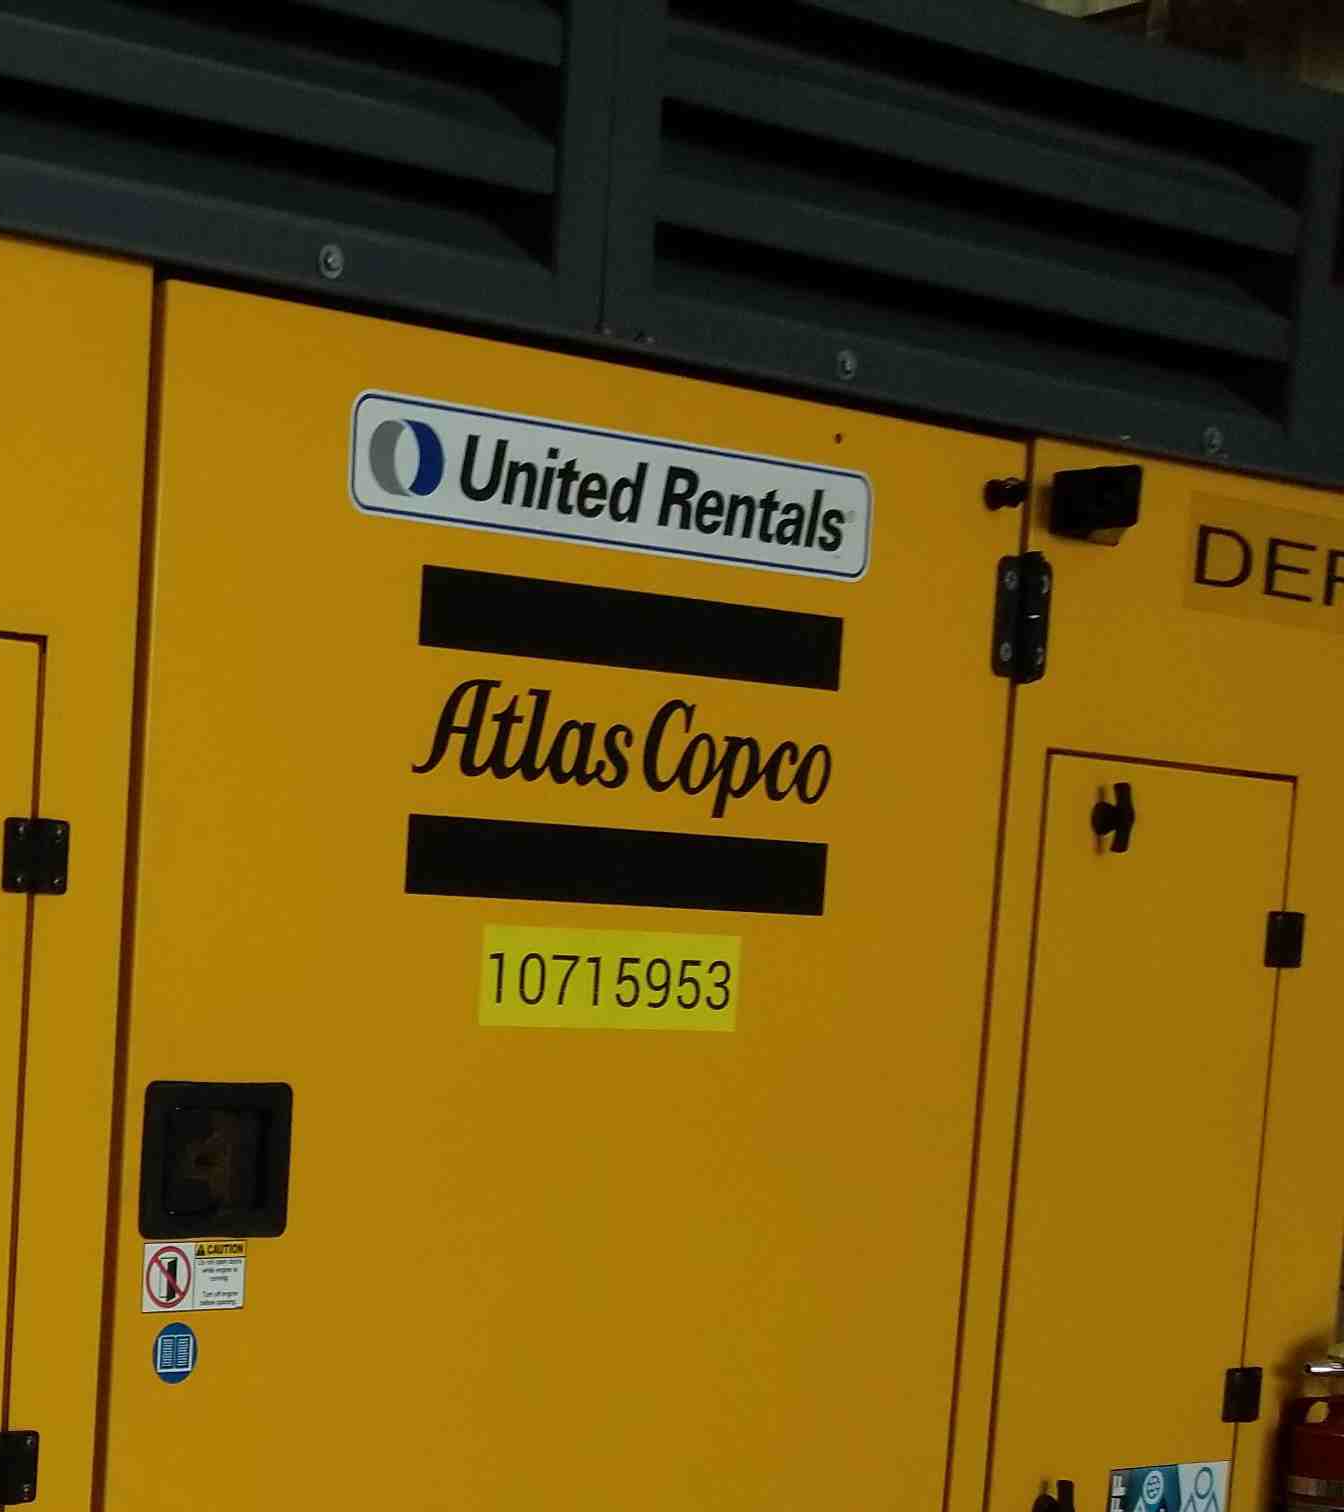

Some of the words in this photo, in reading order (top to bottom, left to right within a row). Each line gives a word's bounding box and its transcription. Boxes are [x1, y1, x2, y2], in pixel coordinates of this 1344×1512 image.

[459, 434, 649, 524] United
[656, 465, 845, 553] Rentals
[411, 677, 635, 789] Atlas
[642, 698, 833, 819] Copco
[488, 951, 733, 1011] 10715953
